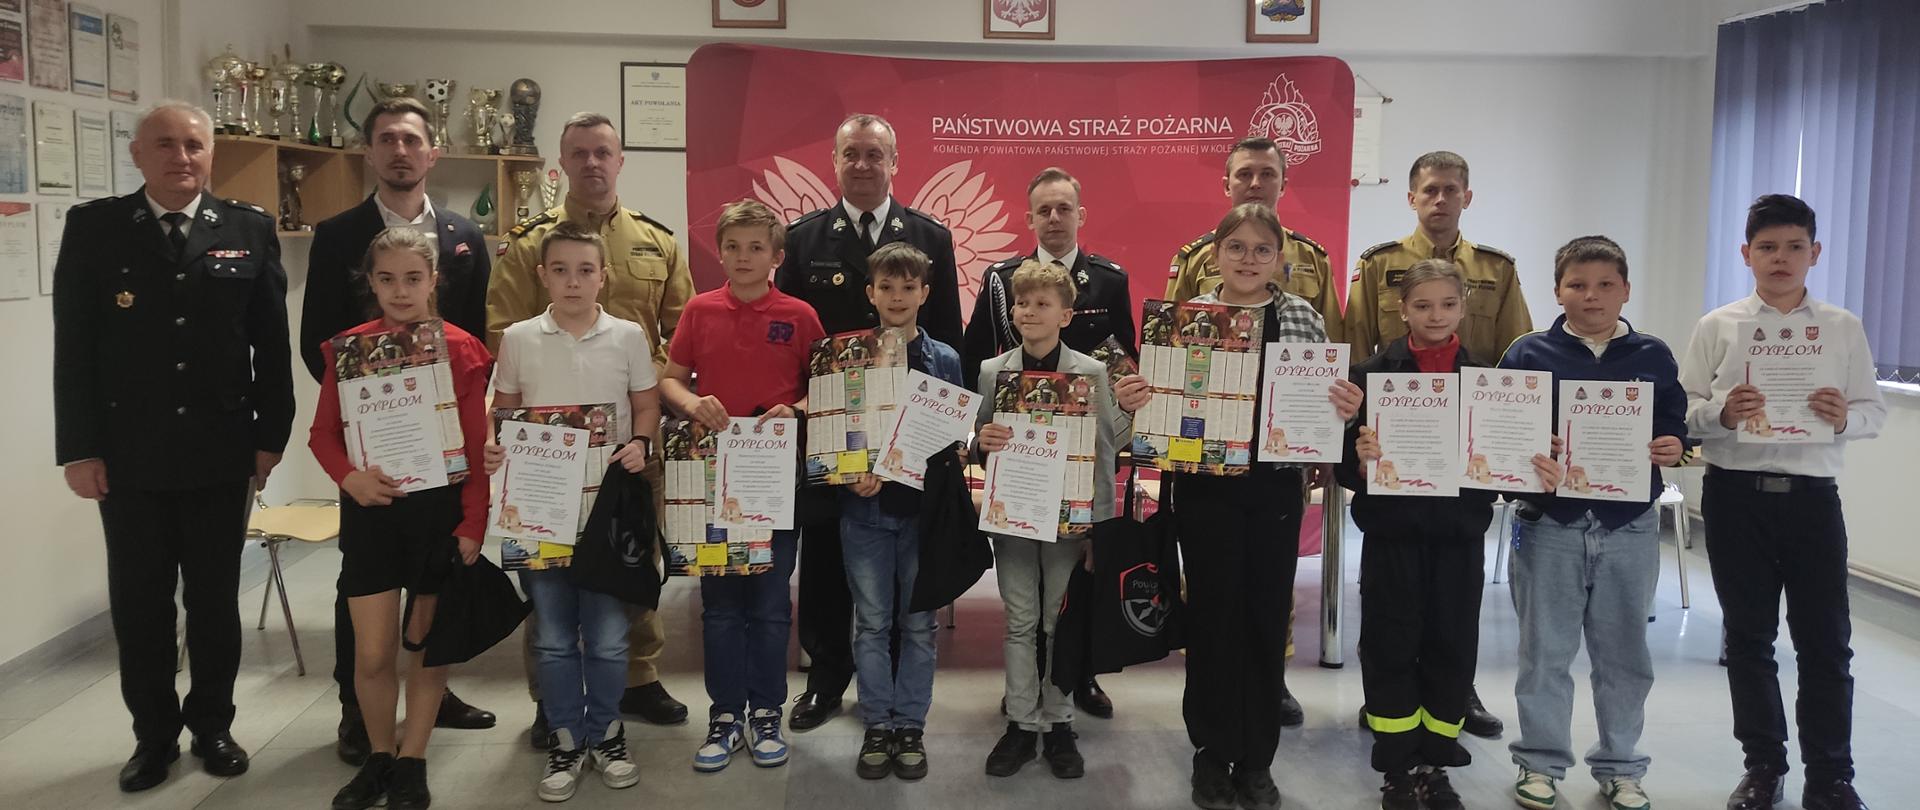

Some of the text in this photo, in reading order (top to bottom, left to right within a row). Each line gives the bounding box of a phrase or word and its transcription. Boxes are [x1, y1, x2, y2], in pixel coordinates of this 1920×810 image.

[932, 113, 1233, 136] PAŃSTWOWA STRAŻ POŻARNA
[933, 143, 1233, 156] KOMENDA POWIATOWA PAŃSTWOWEJ STRAŻY POŻARNEJ W KOLE
[1748, 344, 1823, 356] DYPLOM
[1275, 365, 1341, 378] DYPLOM
[357, 394, 423, 415] DYPLOM
[1378, 396, 1449, 408] DYPLOM
[1472, 390, 1543, 405] DYPLOM
[910, 393, 968, 422] DYPLOM
[1570, 403, 1642, 417] DYPLOM
[727, 439, 789, 450] DYPLOM
[1000, 442, 1059, 459] DYPLOM
[511, 444, 577, 462] DYPLOM
